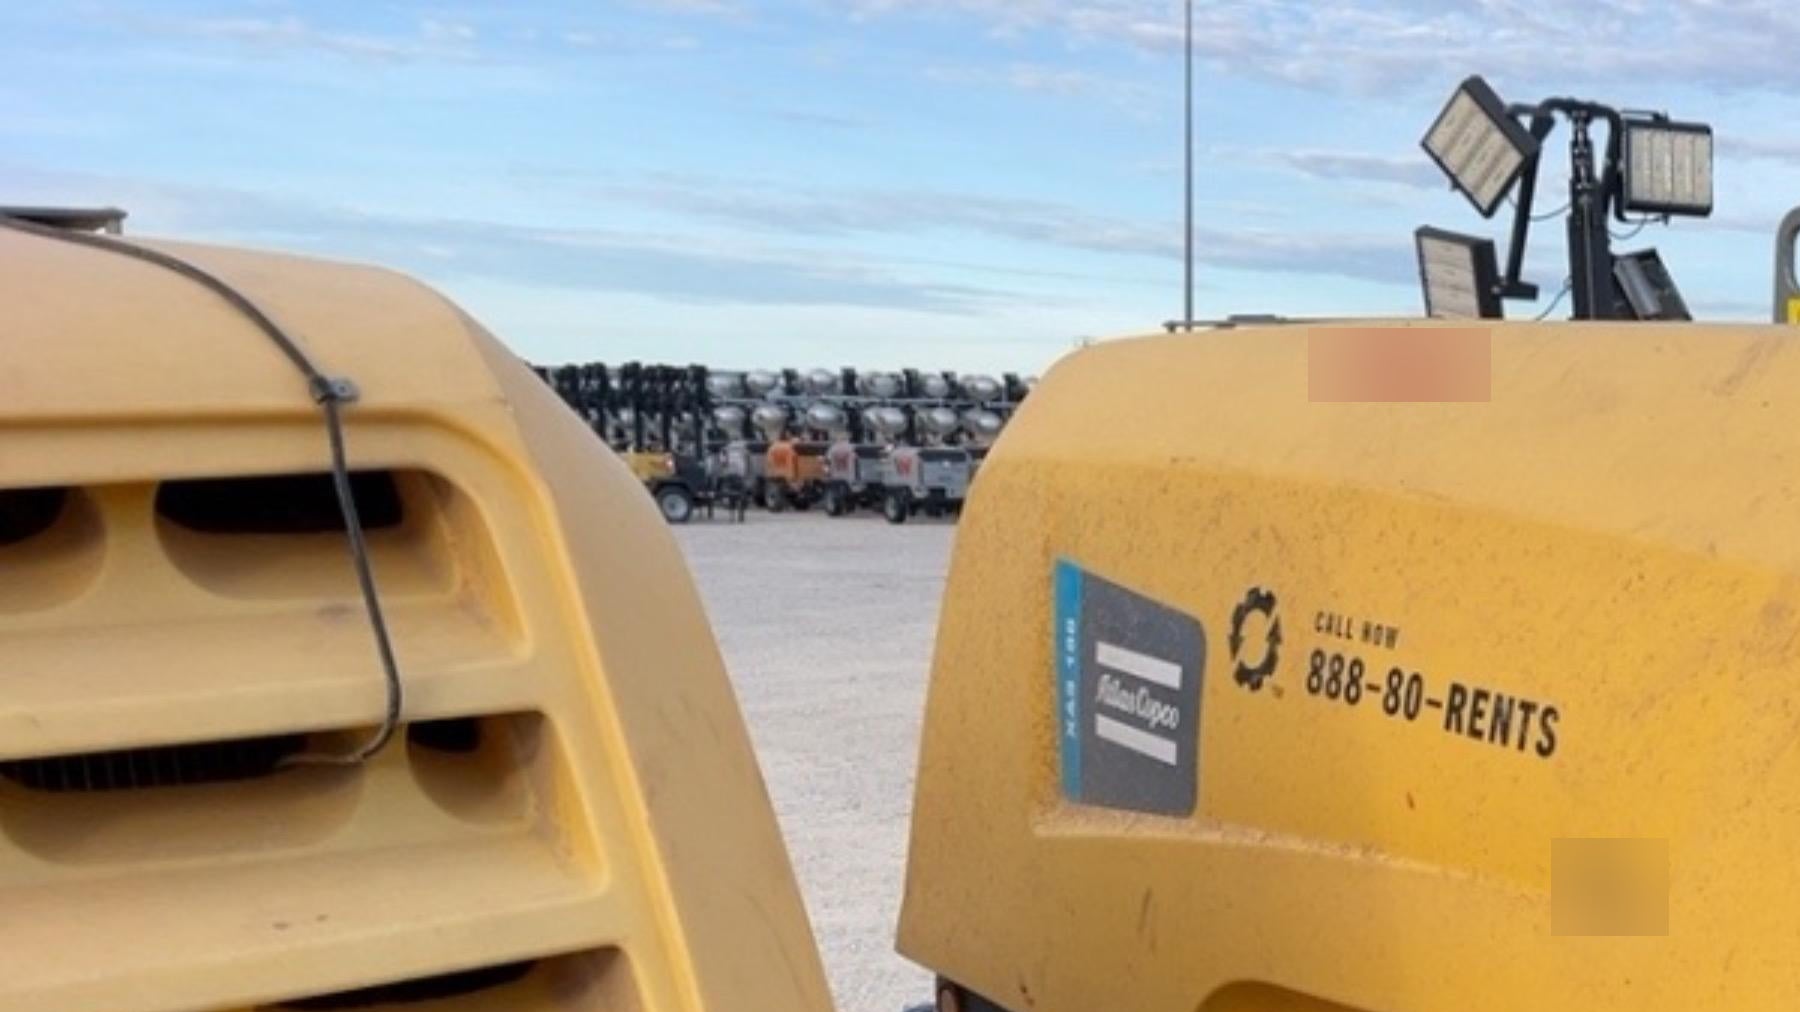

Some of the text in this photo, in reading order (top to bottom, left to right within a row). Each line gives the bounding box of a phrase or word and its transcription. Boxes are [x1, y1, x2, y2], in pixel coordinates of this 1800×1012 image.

[1314, 610, 1399, 650] CALL NOW
[1134, 686, 1180, 731] Copco
[1305, 649, 1560, 759] 888-80-RENTS
